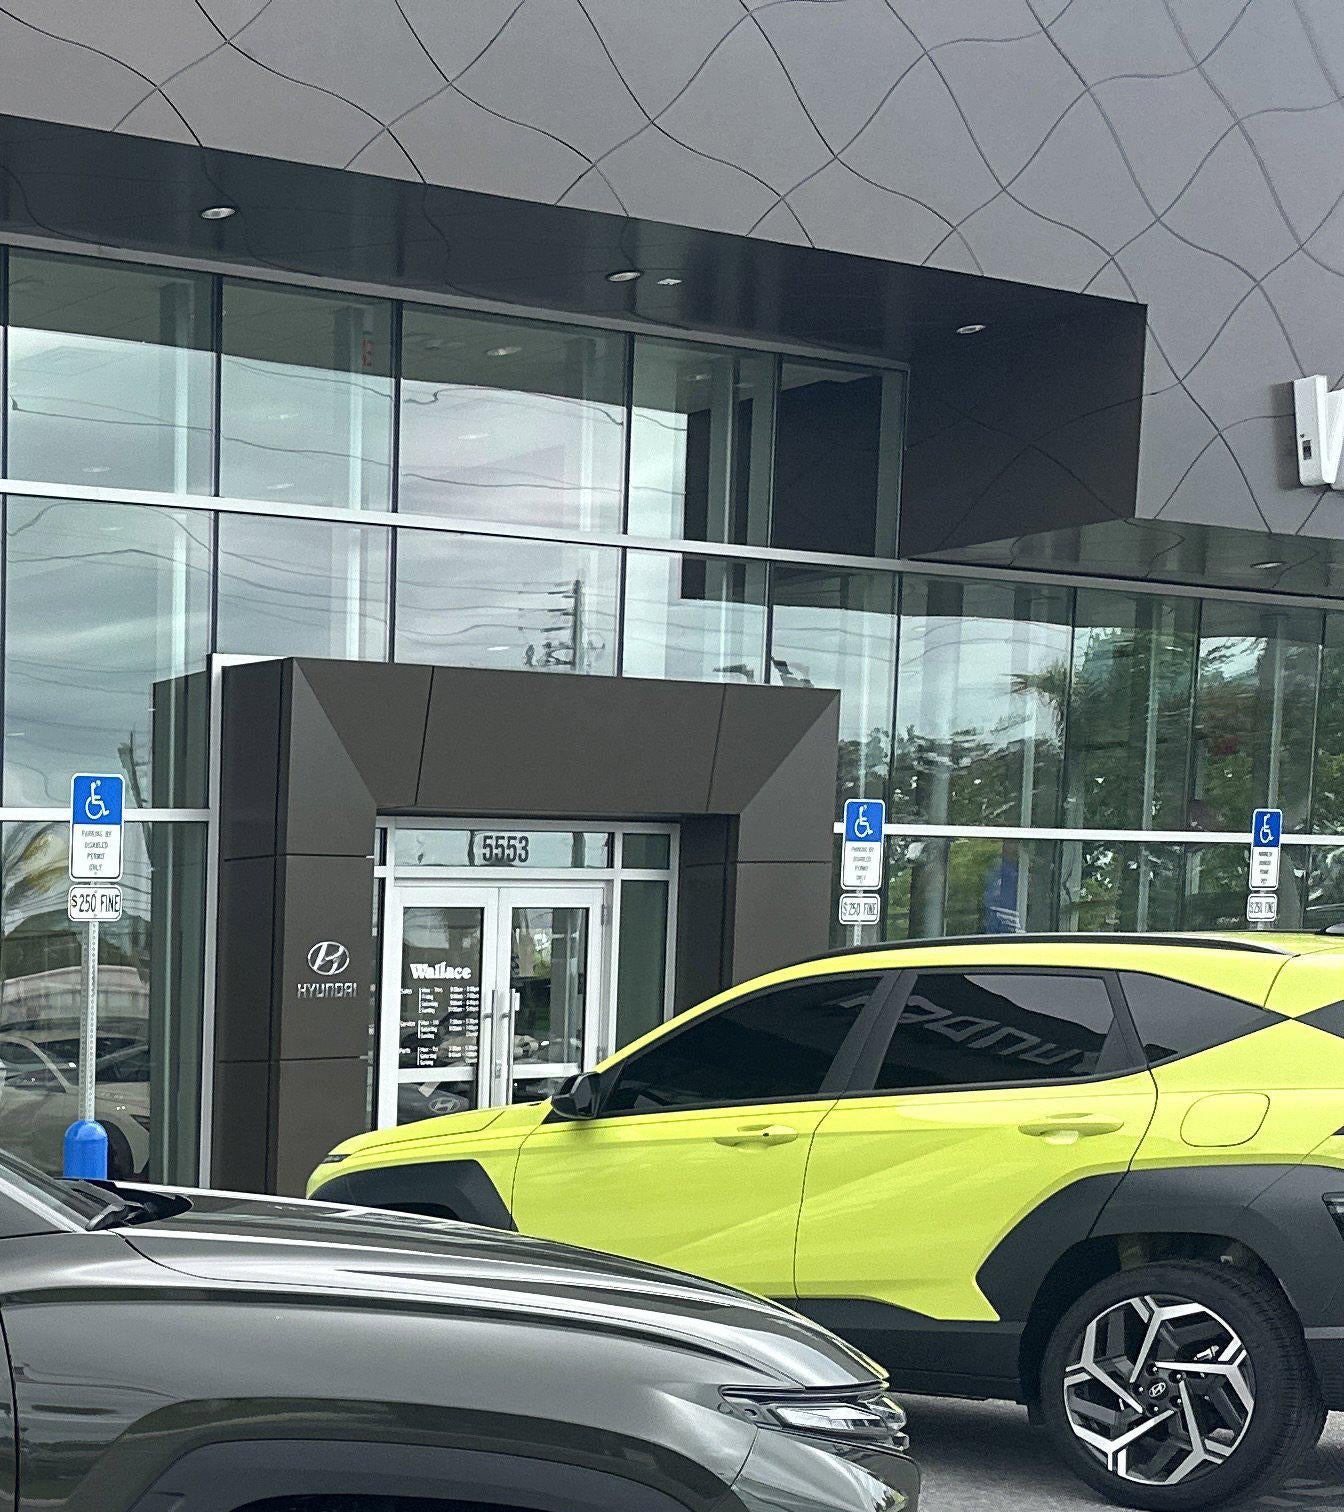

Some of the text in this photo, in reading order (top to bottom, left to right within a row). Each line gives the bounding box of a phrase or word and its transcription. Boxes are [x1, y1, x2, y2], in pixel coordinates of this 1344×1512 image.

[482, 835, 529, 863] 5553
[71, 894, 120, 913] $250 FINE
[410, 961, 472, 979] Wallace
[297, 982, 357, 998] HYUNDAI
